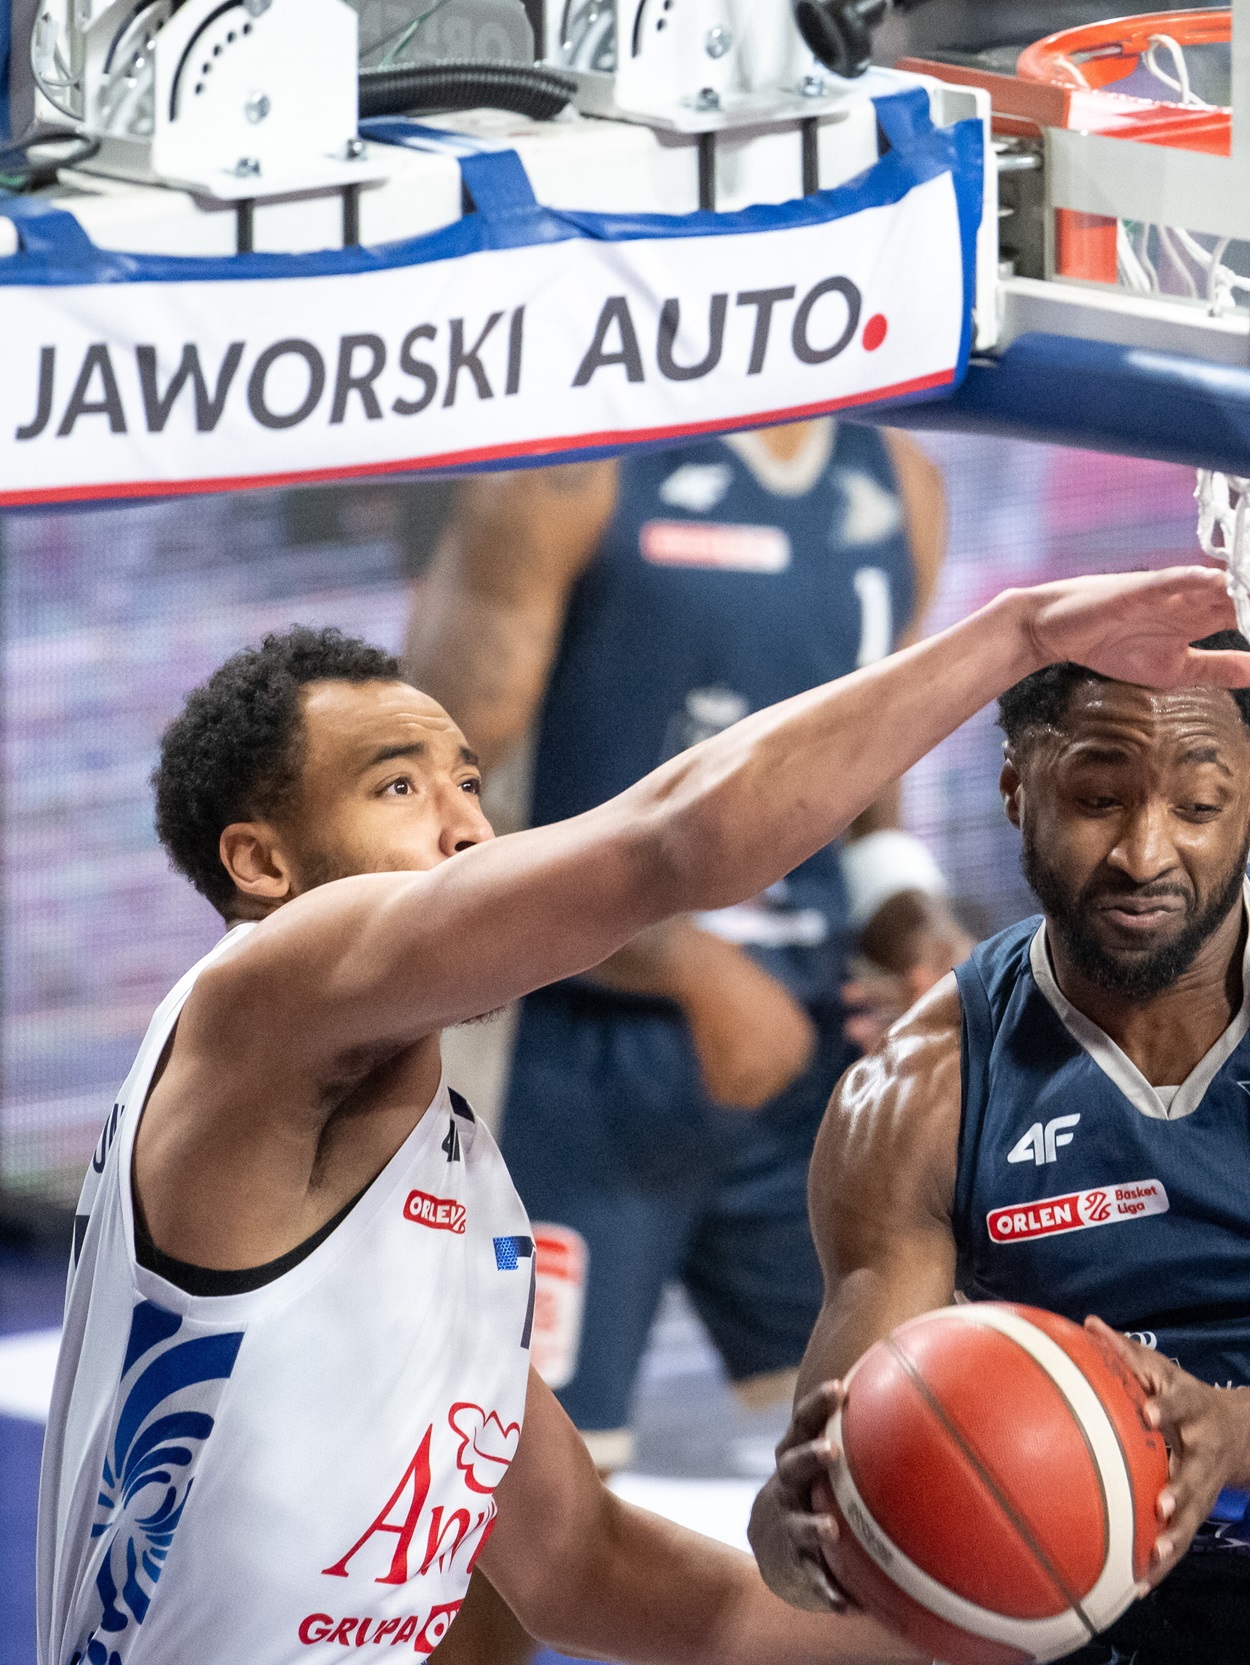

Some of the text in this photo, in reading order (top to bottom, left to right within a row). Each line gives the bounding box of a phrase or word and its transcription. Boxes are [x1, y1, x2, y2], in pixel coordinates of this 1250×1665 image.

[16, 304, 525, 441] JAWORSKI
[1007, 1112, 1081, 1166] 4F
[1114, 1185, 1157, 1201] Basket
[1116, 1200, 1146, 1215] Liga
[996, 1202, 1073, 1236] ORLEN
